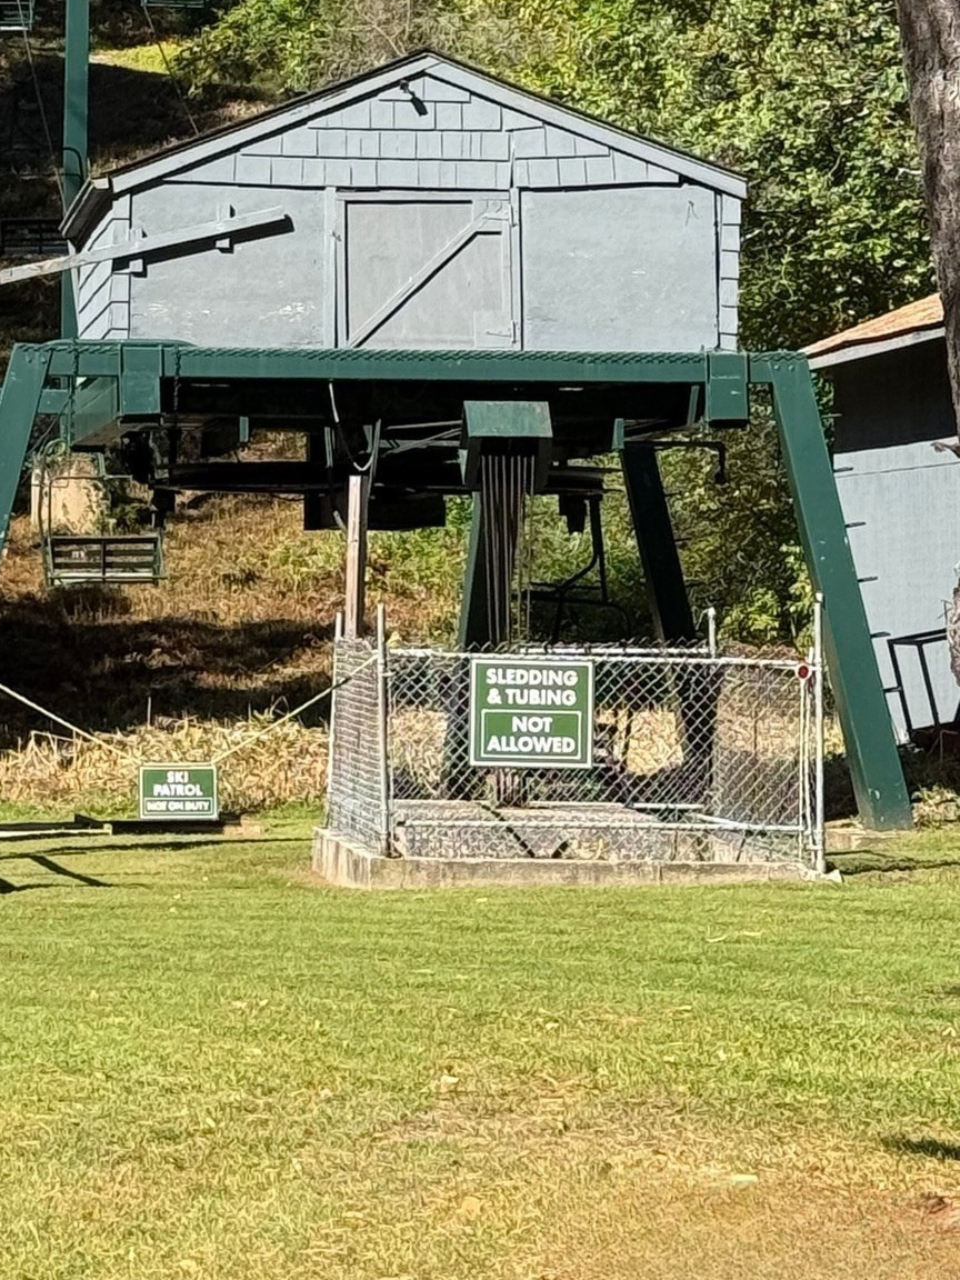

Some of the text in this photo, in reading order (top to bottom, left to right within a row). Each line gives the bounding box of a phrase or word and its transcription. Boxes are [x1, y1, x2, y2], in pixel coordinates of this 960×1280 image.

[486, 668, 578, 686] SLEDDING
[487, 688, 577, 706] & TUBING
[512, 716, 553, 733] NOT
[487, 736, 575, 753] ALLOWED
[167, 771, 189, 783] SKI
[153, 784, 203, 796] PATROL
[185, 801, 209, 811] DUTY
